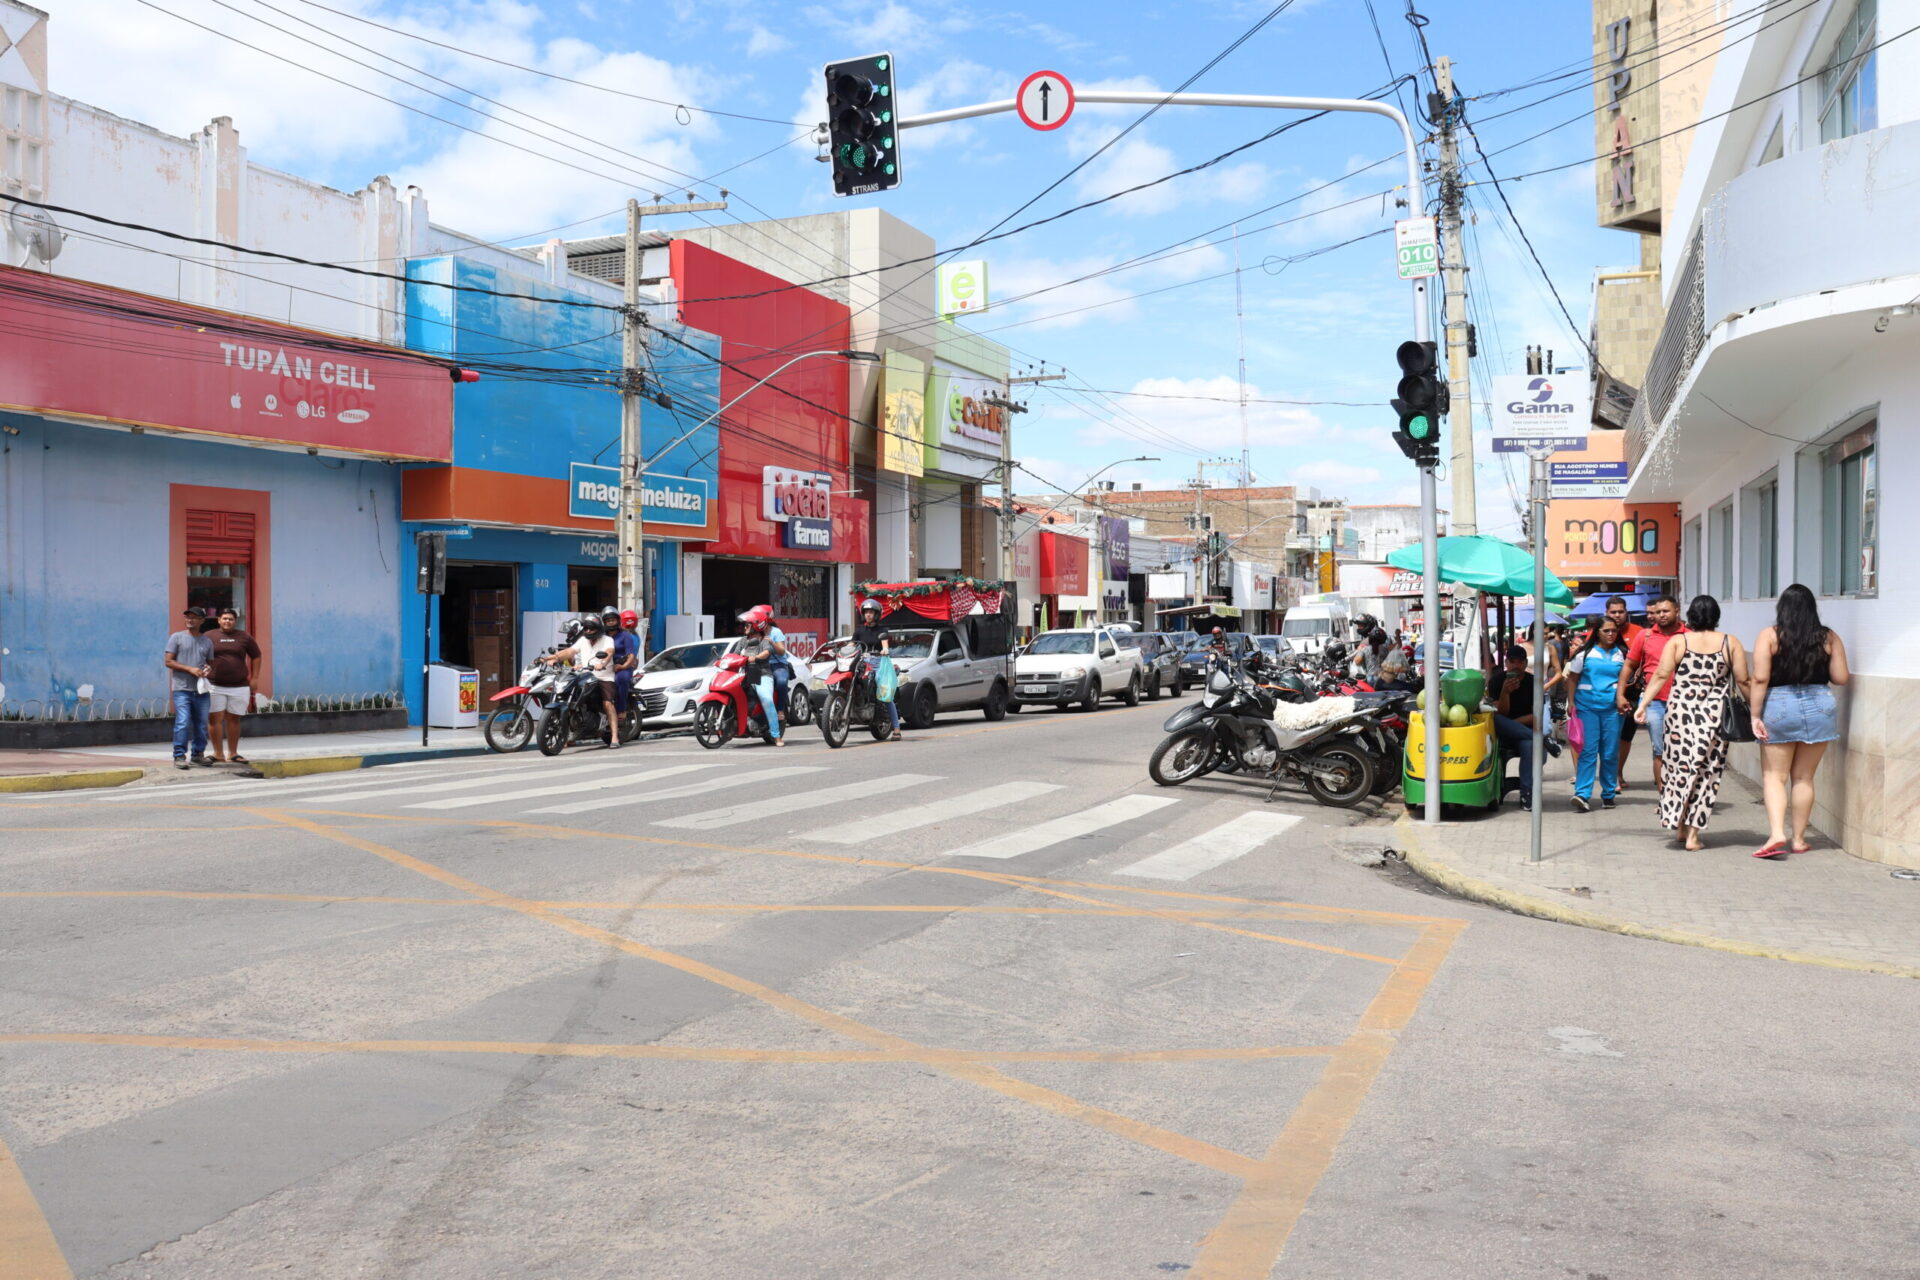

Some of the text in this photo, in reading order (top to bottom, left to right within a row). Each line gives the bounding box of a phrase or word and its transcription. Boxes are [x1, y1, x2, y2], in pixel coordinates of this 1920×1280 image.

[852, 182, 880, 195] STTRANS
[1399, 245, 1435, 264] 010
[219, 341, 376, 391] TUPAN CELL
[311, 405, 326, 417] LG
[1506, 401, 1575, 414] Gama
[578, 480, 703, 511] magineluiza
[774, 471, 829, 519] ideia
[793, 520, 831, 547] farma
[1563, 532, 1588, 542] PONTO
[1564, 510, 1660, 555] moda
